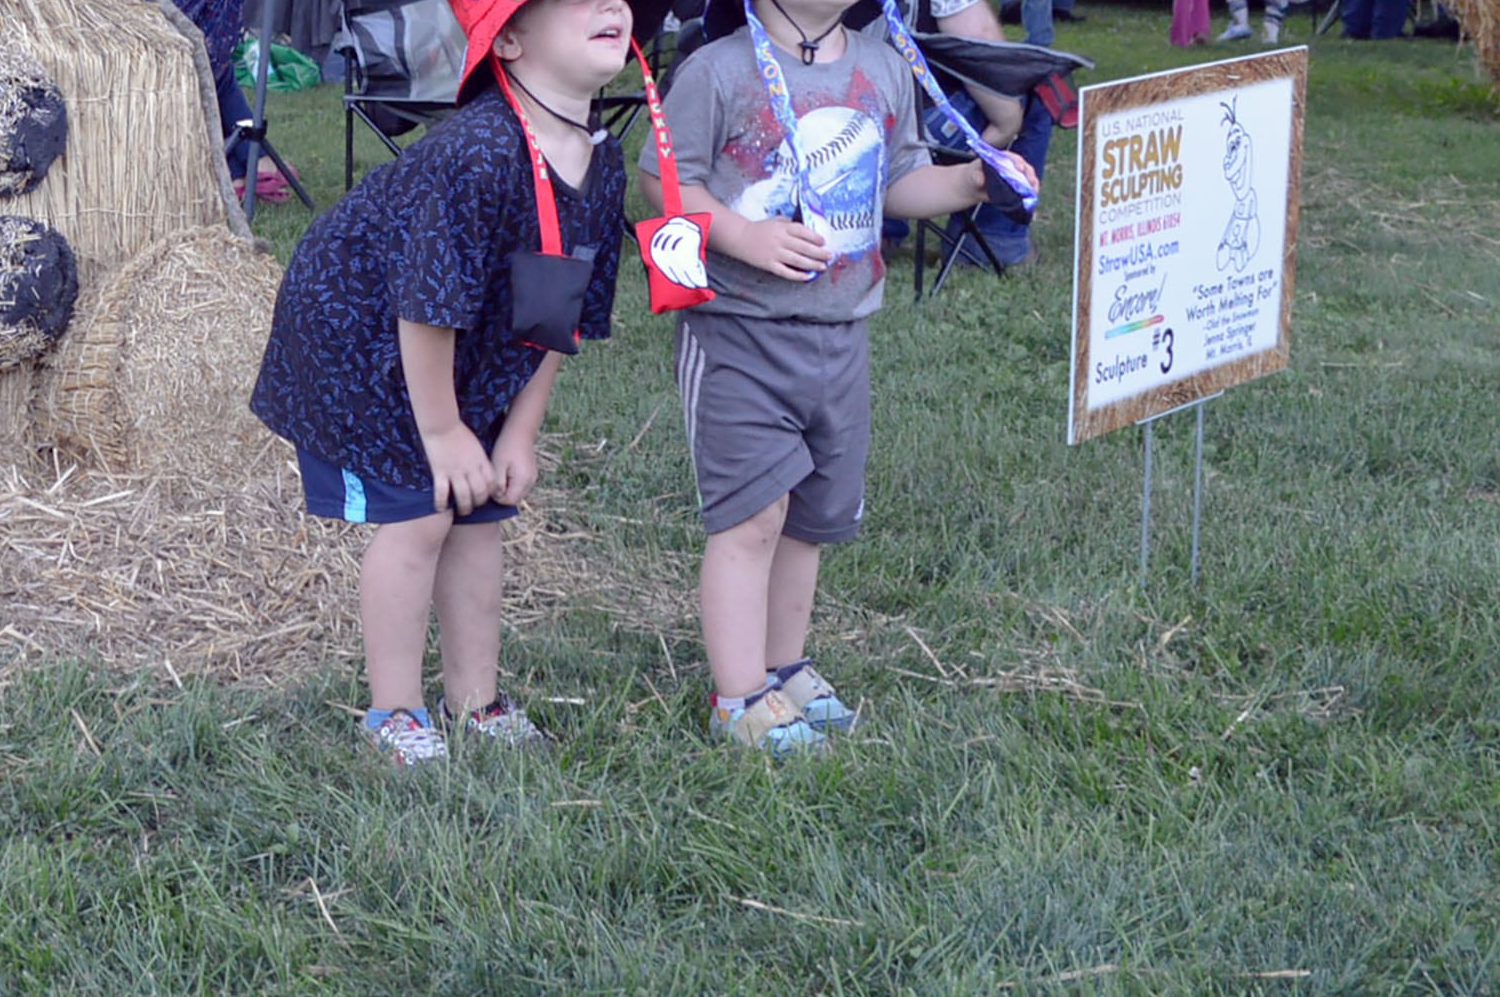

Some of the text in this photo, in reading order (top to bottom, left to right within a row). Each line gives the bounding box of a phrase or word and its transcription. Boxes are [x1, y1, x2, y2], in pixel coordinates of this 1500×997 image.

[643, 73, 673, 160] MICKEY
[1102, 109, 1184, 137] U.S. NATIONAL
[1102, 124, 1183, 179] STRAW
[1100, 164, 1183, 208] SCULPTING
[1099, 192, 1182, 224] COMPETITION
[1098, 240, 1180, 275] StrawUSA.com
[1227, 273, 1255, 291] Towns
[1257, 268, 1274, 282] are
[1186, 300, 1215, 323] Worth
[1218, 291, 1254, 313] Melting
[1095, 353, 1148, 384] Sculpture
